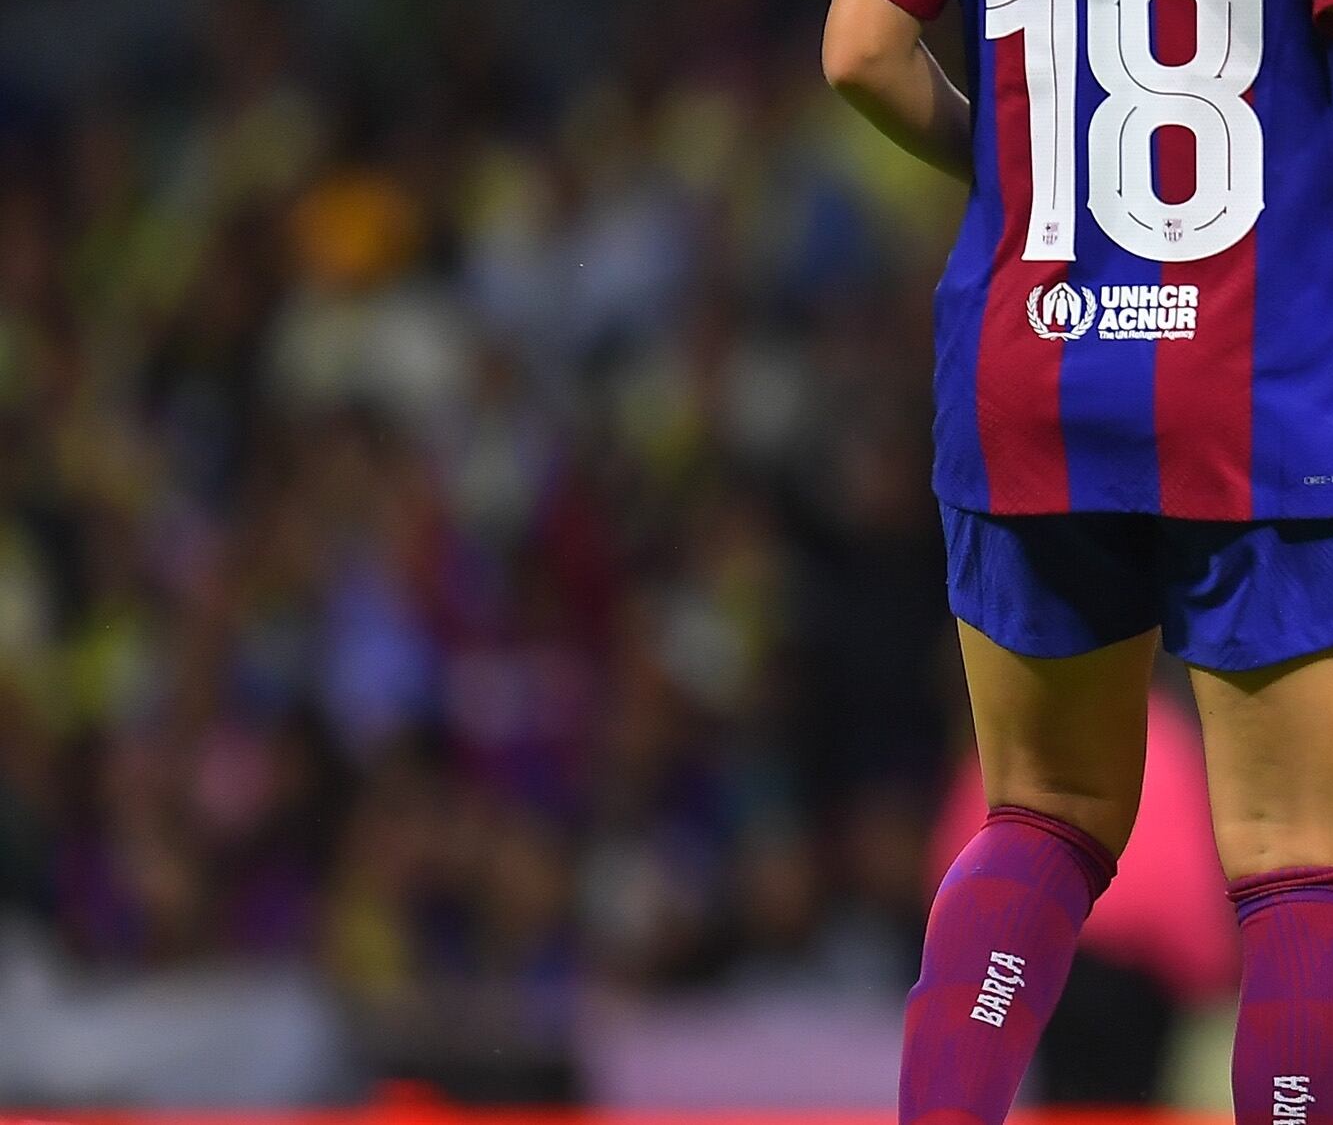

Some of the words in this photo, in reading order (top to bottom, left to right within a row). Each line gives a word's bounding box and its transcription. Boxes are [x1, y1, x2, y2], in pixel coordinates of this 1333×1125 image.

[1101, 285, 1199, 307] UNHCR
[1098, 307, 1197, 330] ACNUR
[969, 951, 1026, 1027] BARÇA
